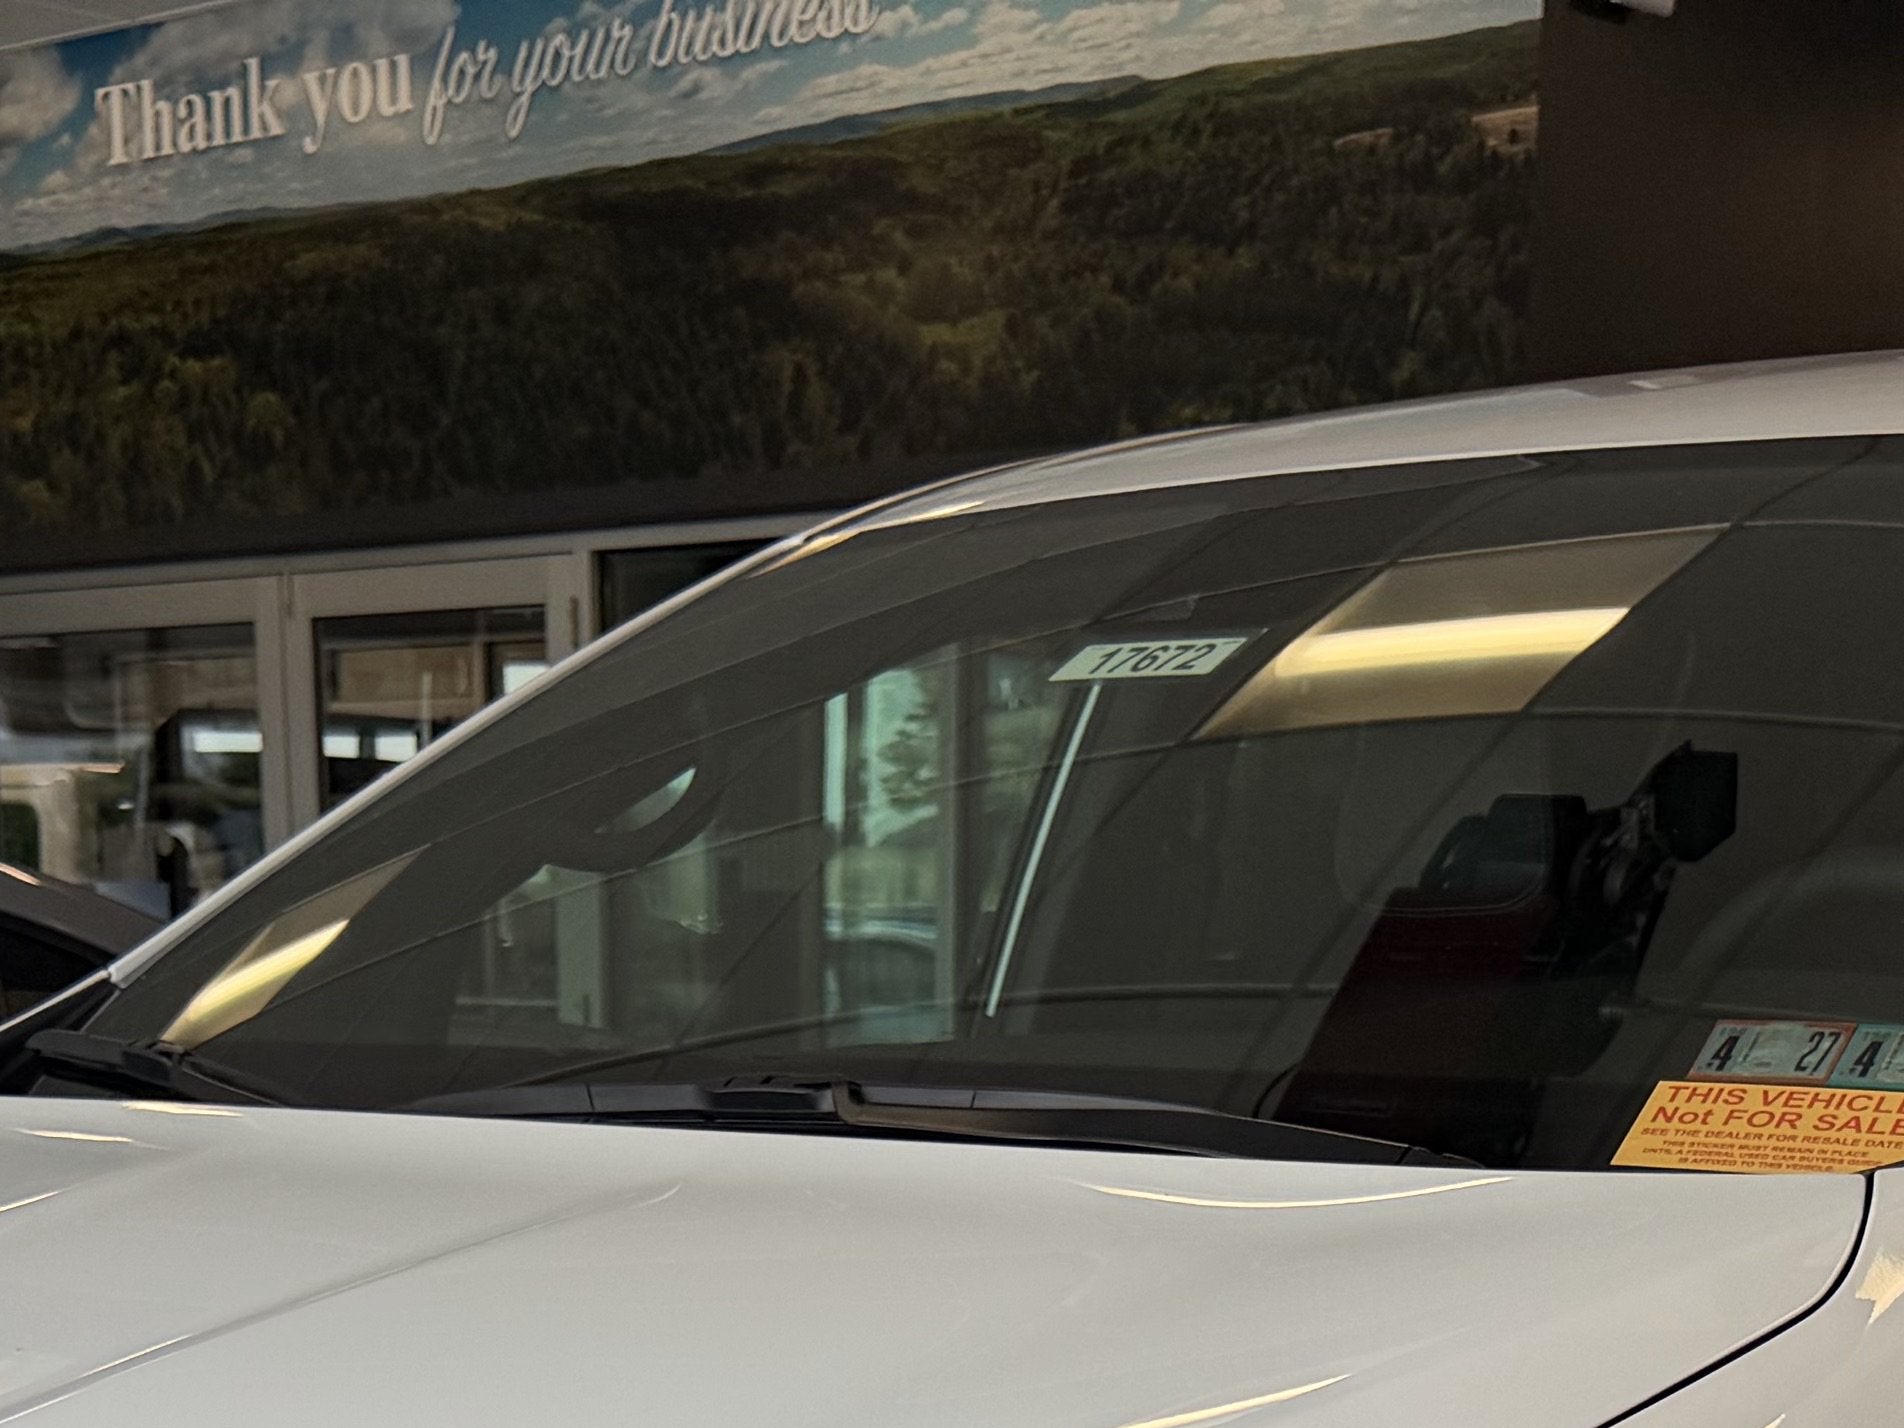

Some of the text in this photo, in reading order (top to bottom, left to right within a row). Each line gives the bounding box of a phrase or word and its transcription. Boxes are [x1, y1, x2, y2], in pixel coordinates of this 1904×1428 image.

[94, 0, 880, 168] Thank you for your business
[1089, 643, 1217, 675] 17672
[1710, 1031, 1842, 1073] 4 27
[1852, 1040, 1884, 1078] 4
[1668, 1085, 1748, 1106] THIS
[1650, 1105, 1714, 1126] Not
[1722, 1109, 1803, 1129] FOR
[1641, 1127, 1904, 1150] SEE THE DEALER FOR RESALE DATE
[1663, 1140, 1686, 1148] THIS
[1688, 1141, 1735, 1150] STICKER
[1737, 1144, 1770, 1152] MUST
[1770, 1145, 1814, 1154] REMAIN
[1830, 1149, 1870, 1158] PLACE
[1738, 1152, 1770, 1160] USED
[1772, 1154, 1798, 1162] CAR
